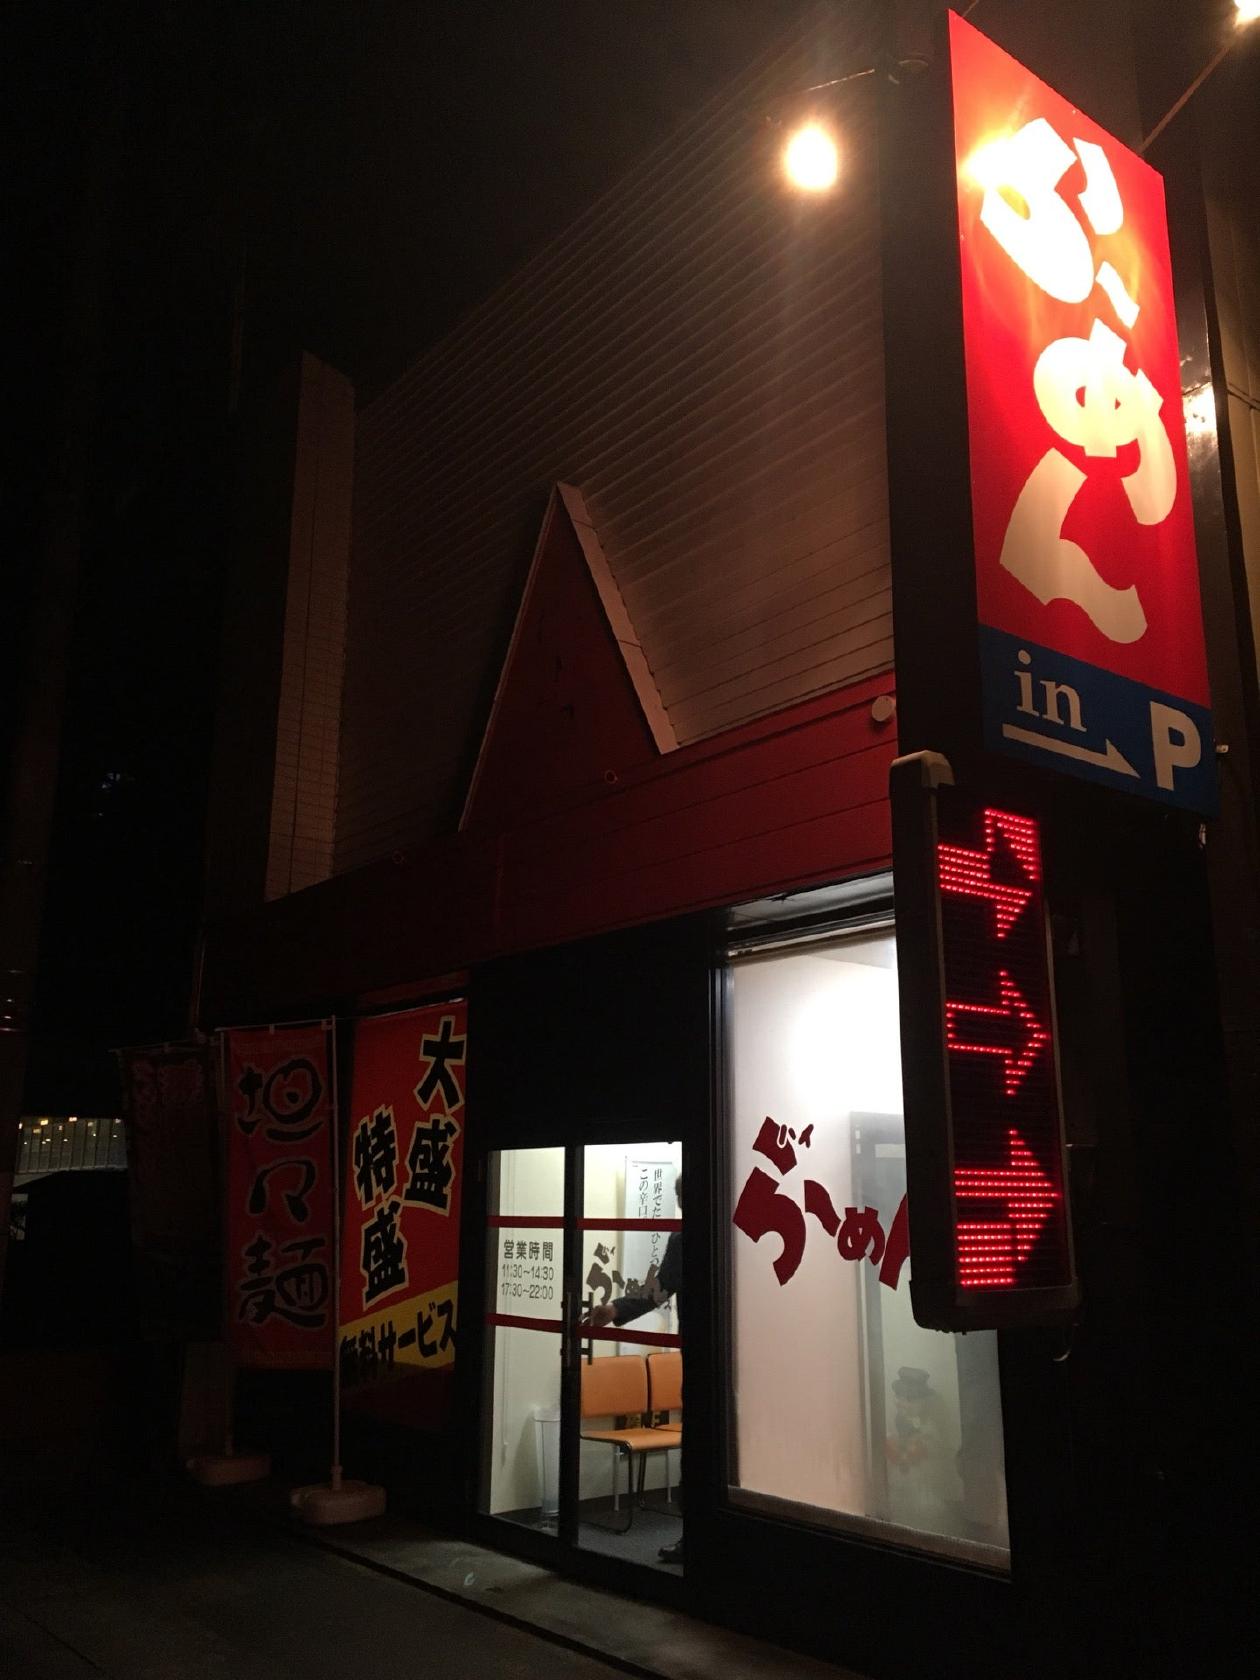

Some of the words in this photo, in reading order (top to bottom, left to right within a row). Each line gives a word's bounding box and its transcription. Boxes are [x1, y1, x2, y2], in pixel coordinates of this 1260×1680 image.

[1014, 650, 1087, 732] in
[1150, 701, 1201, 791] P
[406, 1017, 464, 1212] 大盛
[353, 1108, 407, 1305] 特盛
[504, 1240, 553, 1261] 営業時間
